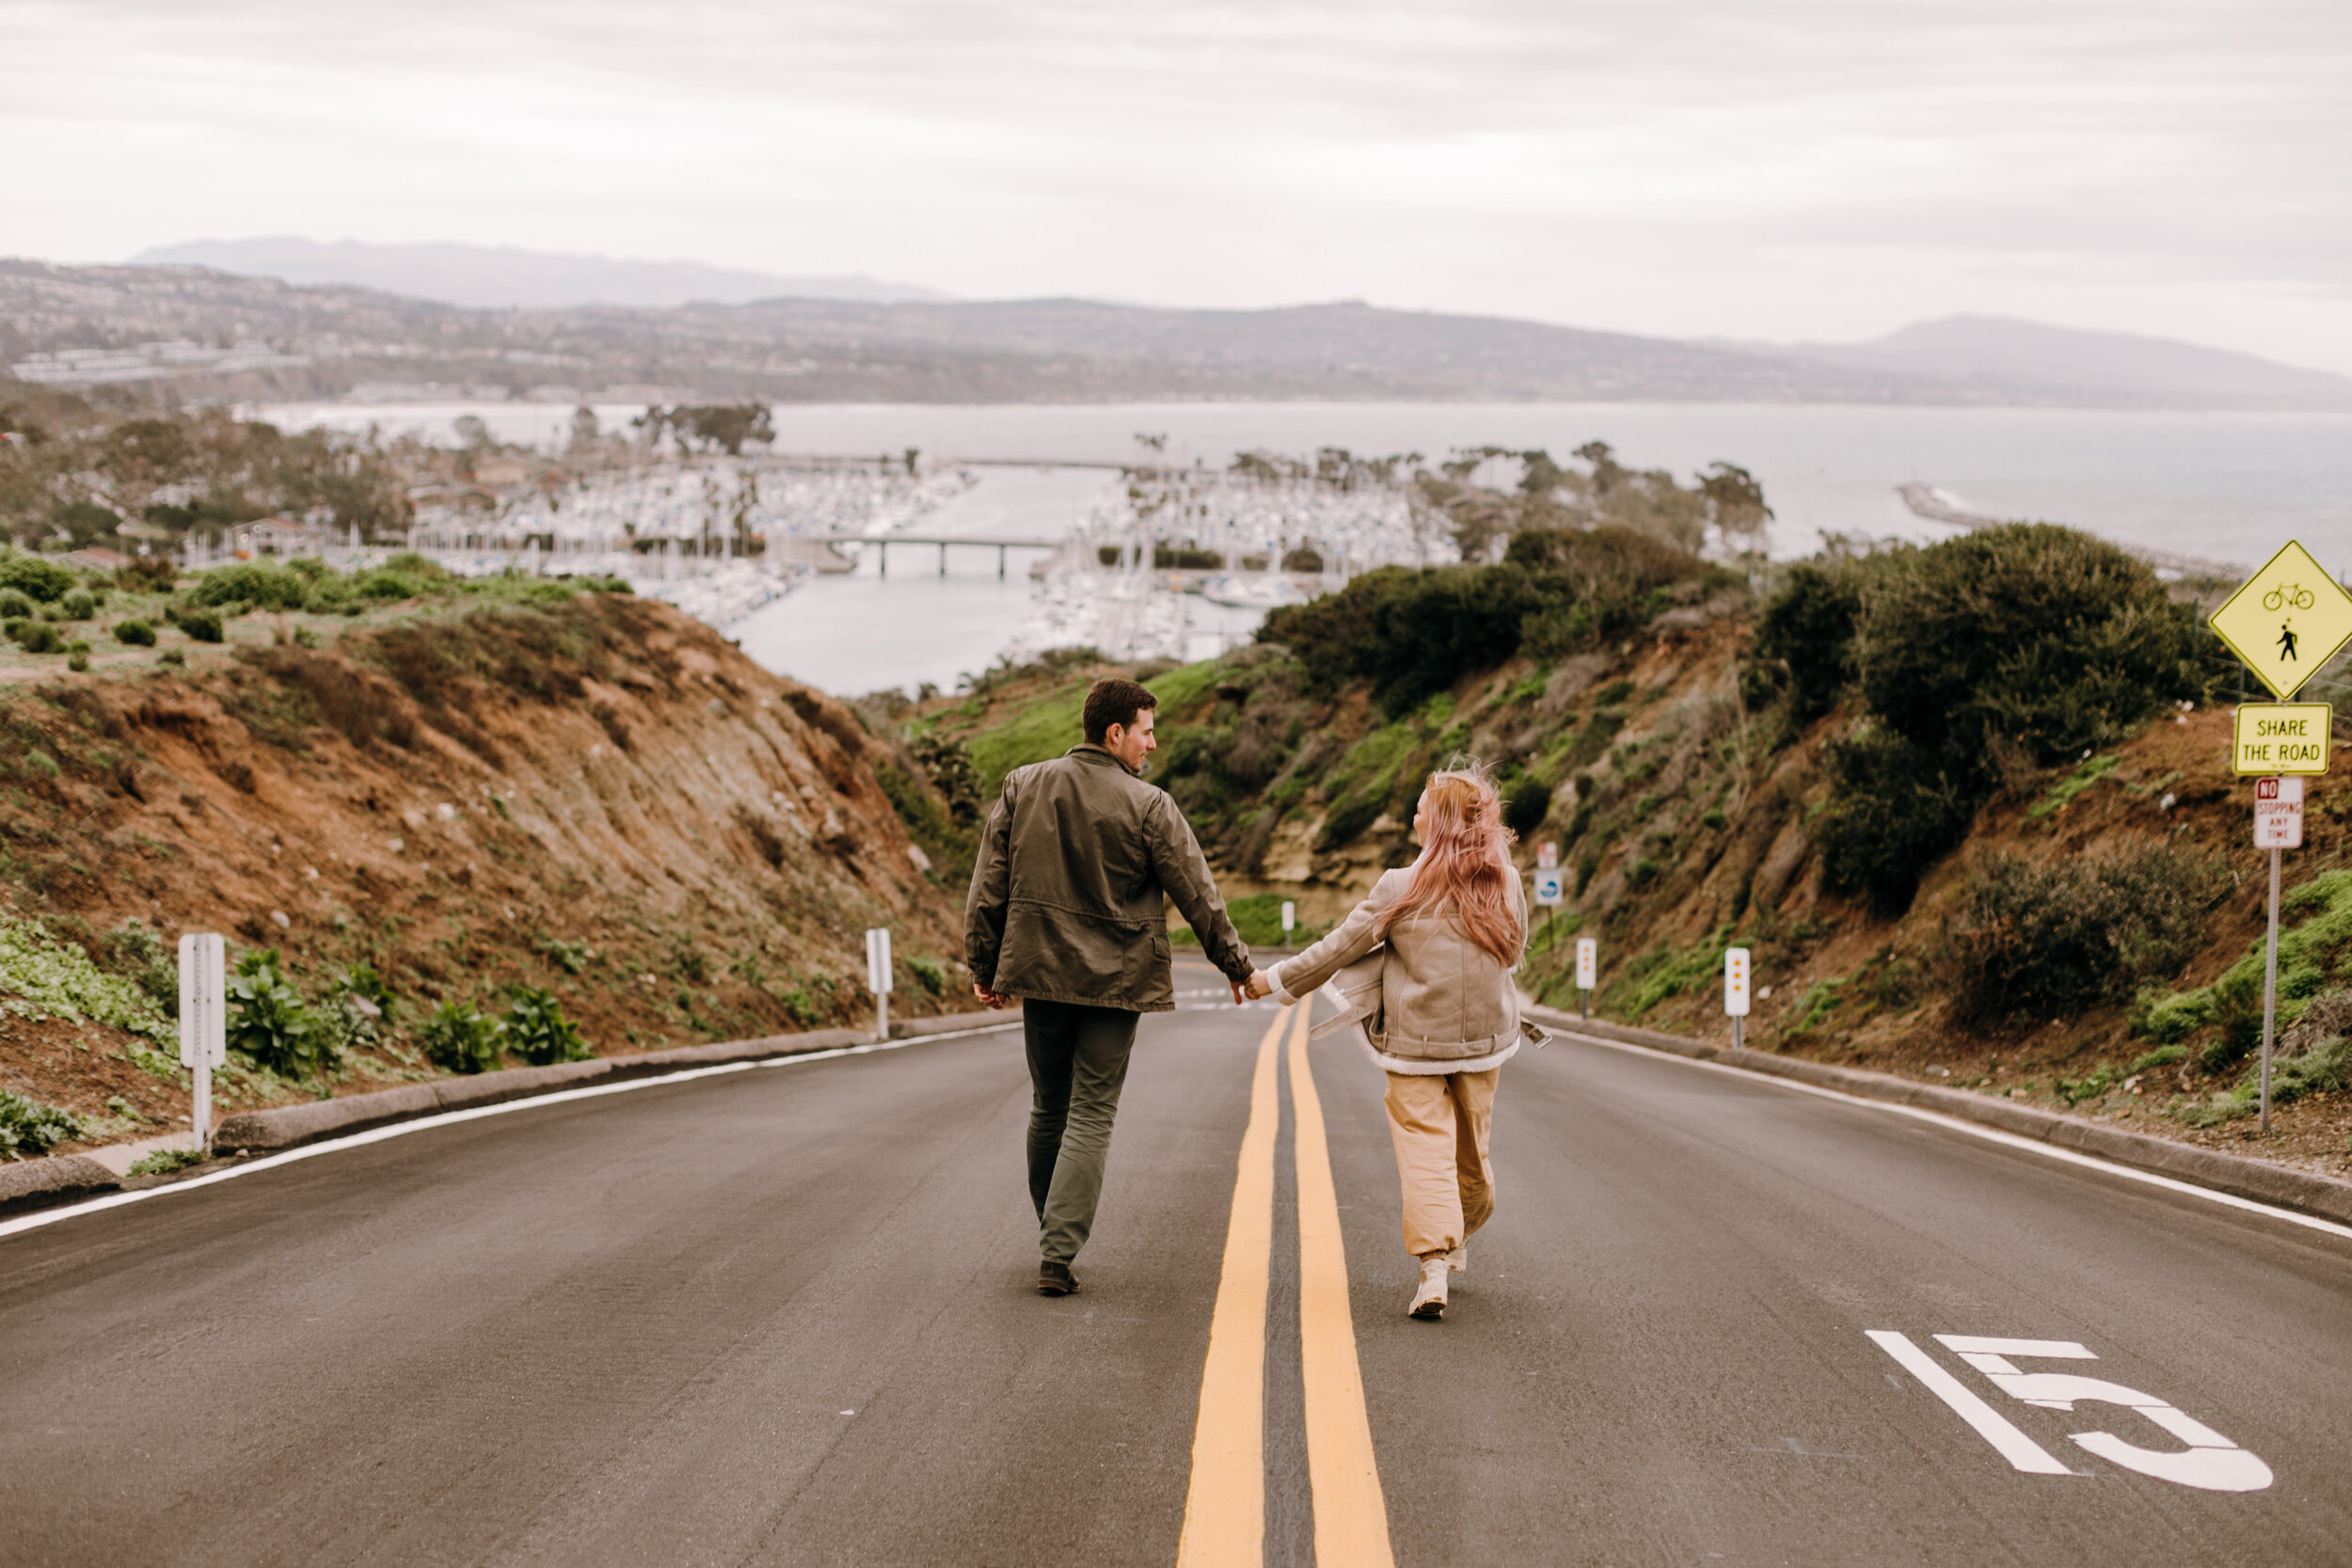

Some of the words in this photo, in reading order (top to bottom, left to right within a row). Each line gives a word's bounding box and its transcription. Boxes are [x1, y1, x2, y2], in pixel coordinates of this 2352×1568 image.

[2257, 720, 2309, 736] SHARE
[2243, 744, 2271, 761] THE
[2279, 744, 2320, 761] ROAD
[2260, 781, 2277, 798] NO
[2259, 801, 2301, 815] STOPPING
[2269, 817, 2289, 827] ANY
[2267, 830, 2289, 839] TIME
[1864, 1329, 2274, 1492] 15
